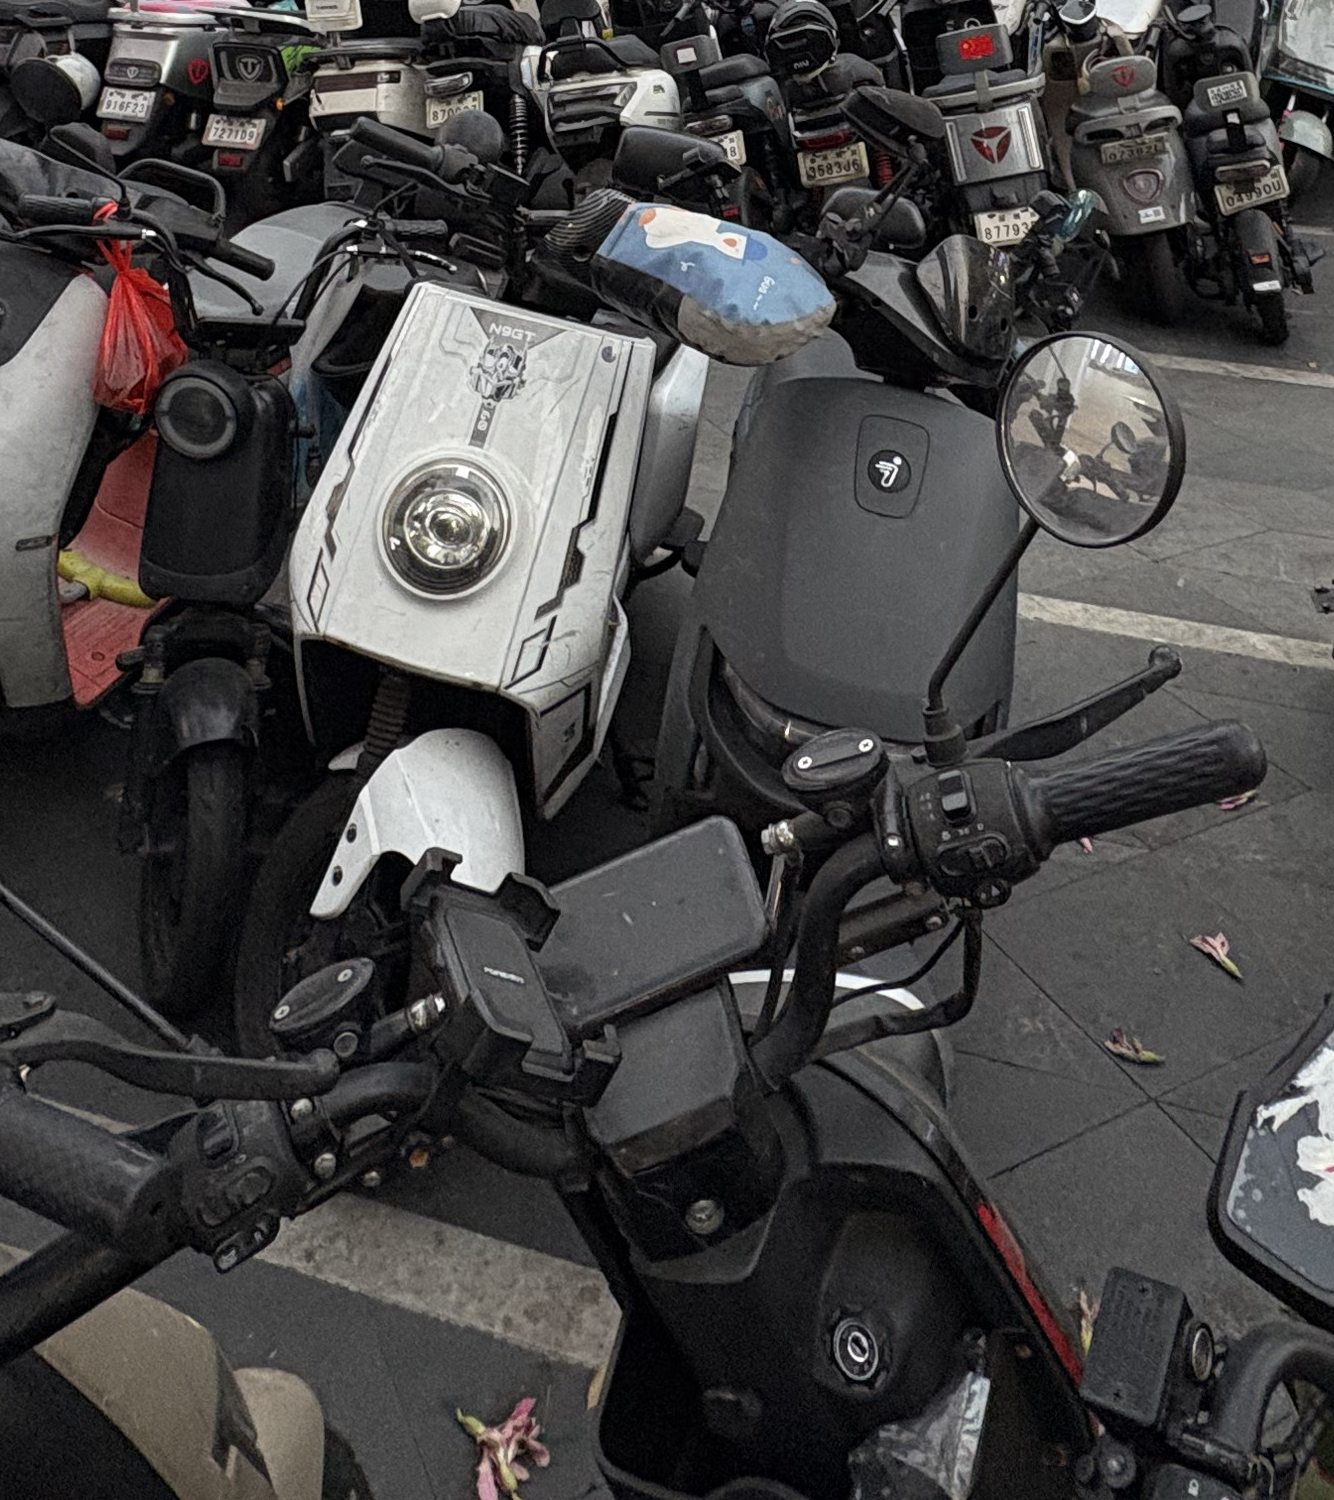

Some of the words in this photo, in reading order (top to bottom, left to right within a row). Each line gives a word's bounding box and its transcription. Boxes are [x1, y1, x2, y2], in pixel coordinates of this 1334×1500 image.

[105, 100, 145, 114] 916F23
[984, 221, 1035, 240] 87793
[489, 322, 536, 343] N9GT
